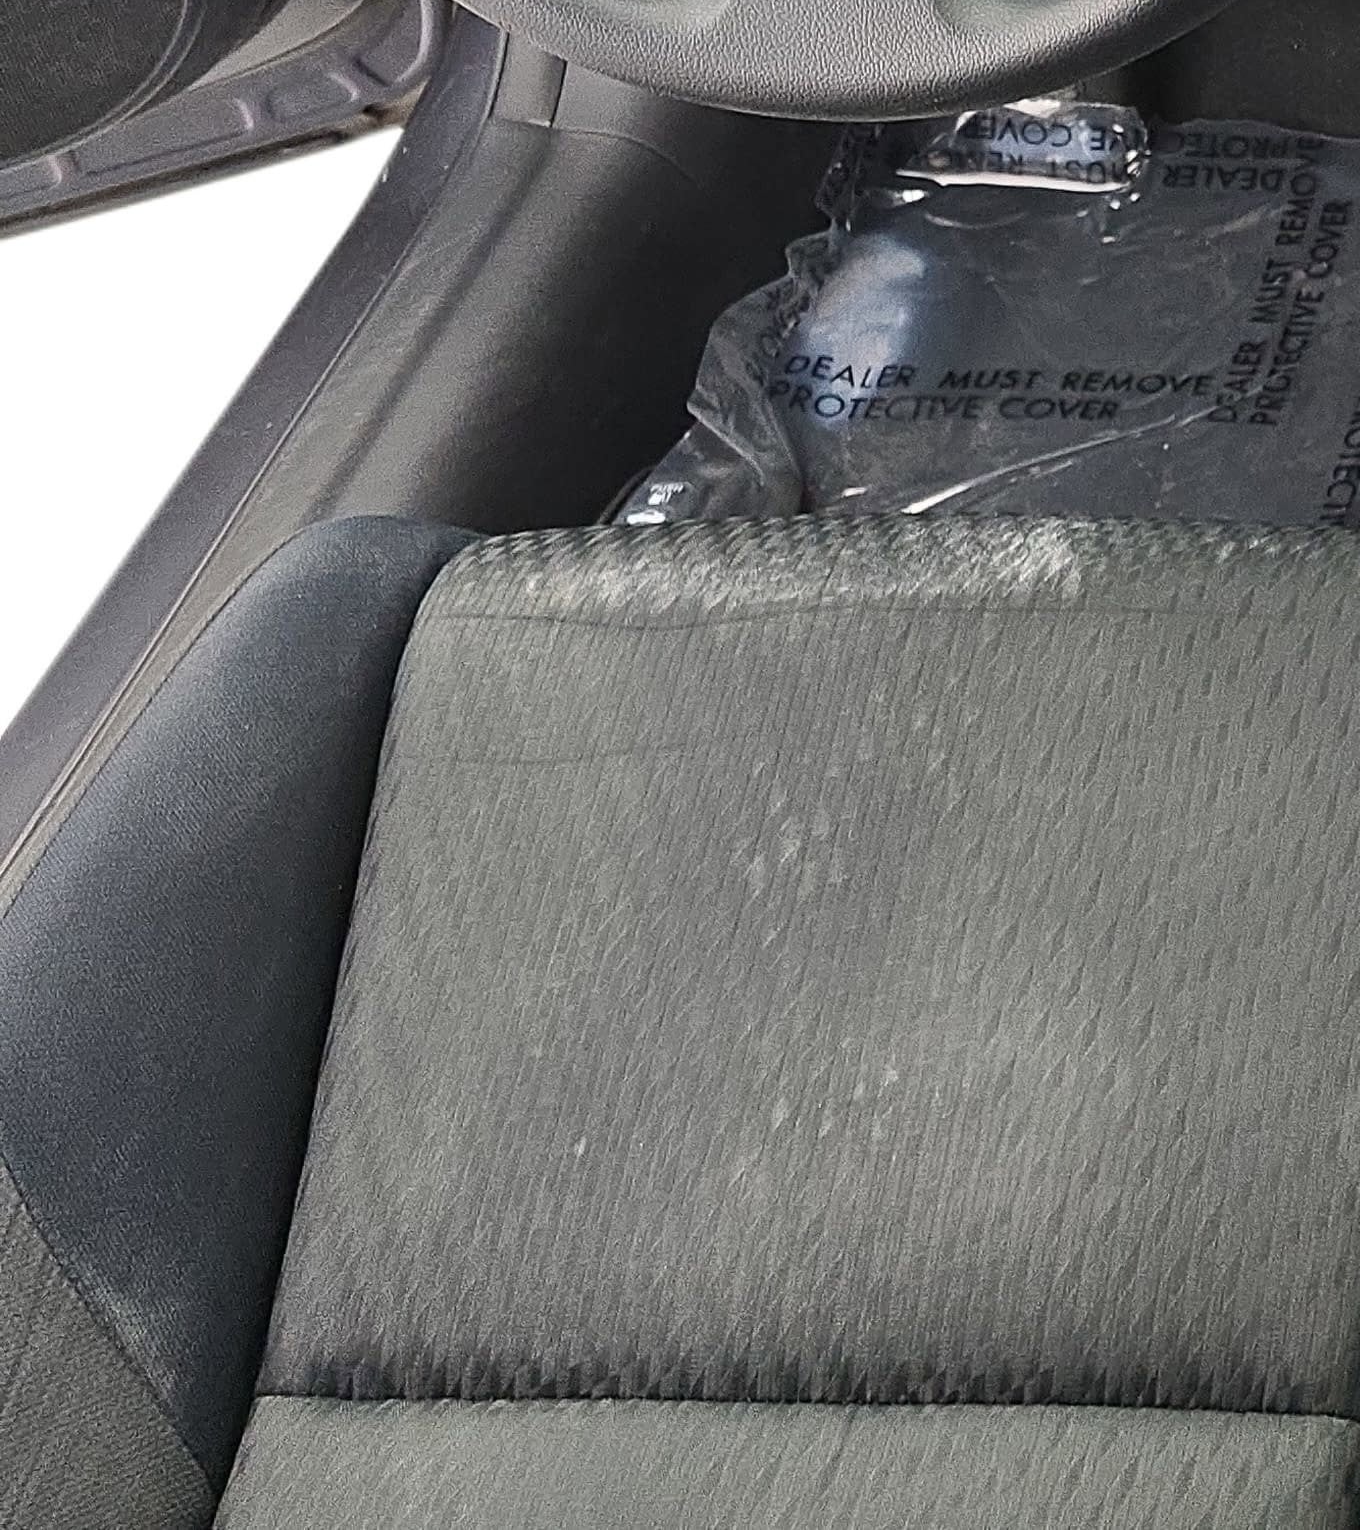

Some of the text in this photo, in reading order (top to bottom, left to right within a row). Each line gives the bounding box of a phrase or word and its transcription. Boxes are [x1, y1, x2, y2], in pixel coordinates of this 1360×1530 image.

[1305, 198, 1353, 281] COVER
[1251, 257, 1293, 326] MUST
[768, 377, 1121, 422] PROTECTIVE COVER
[783, 353, 1218, 398] DEALER MUST REMOVE
